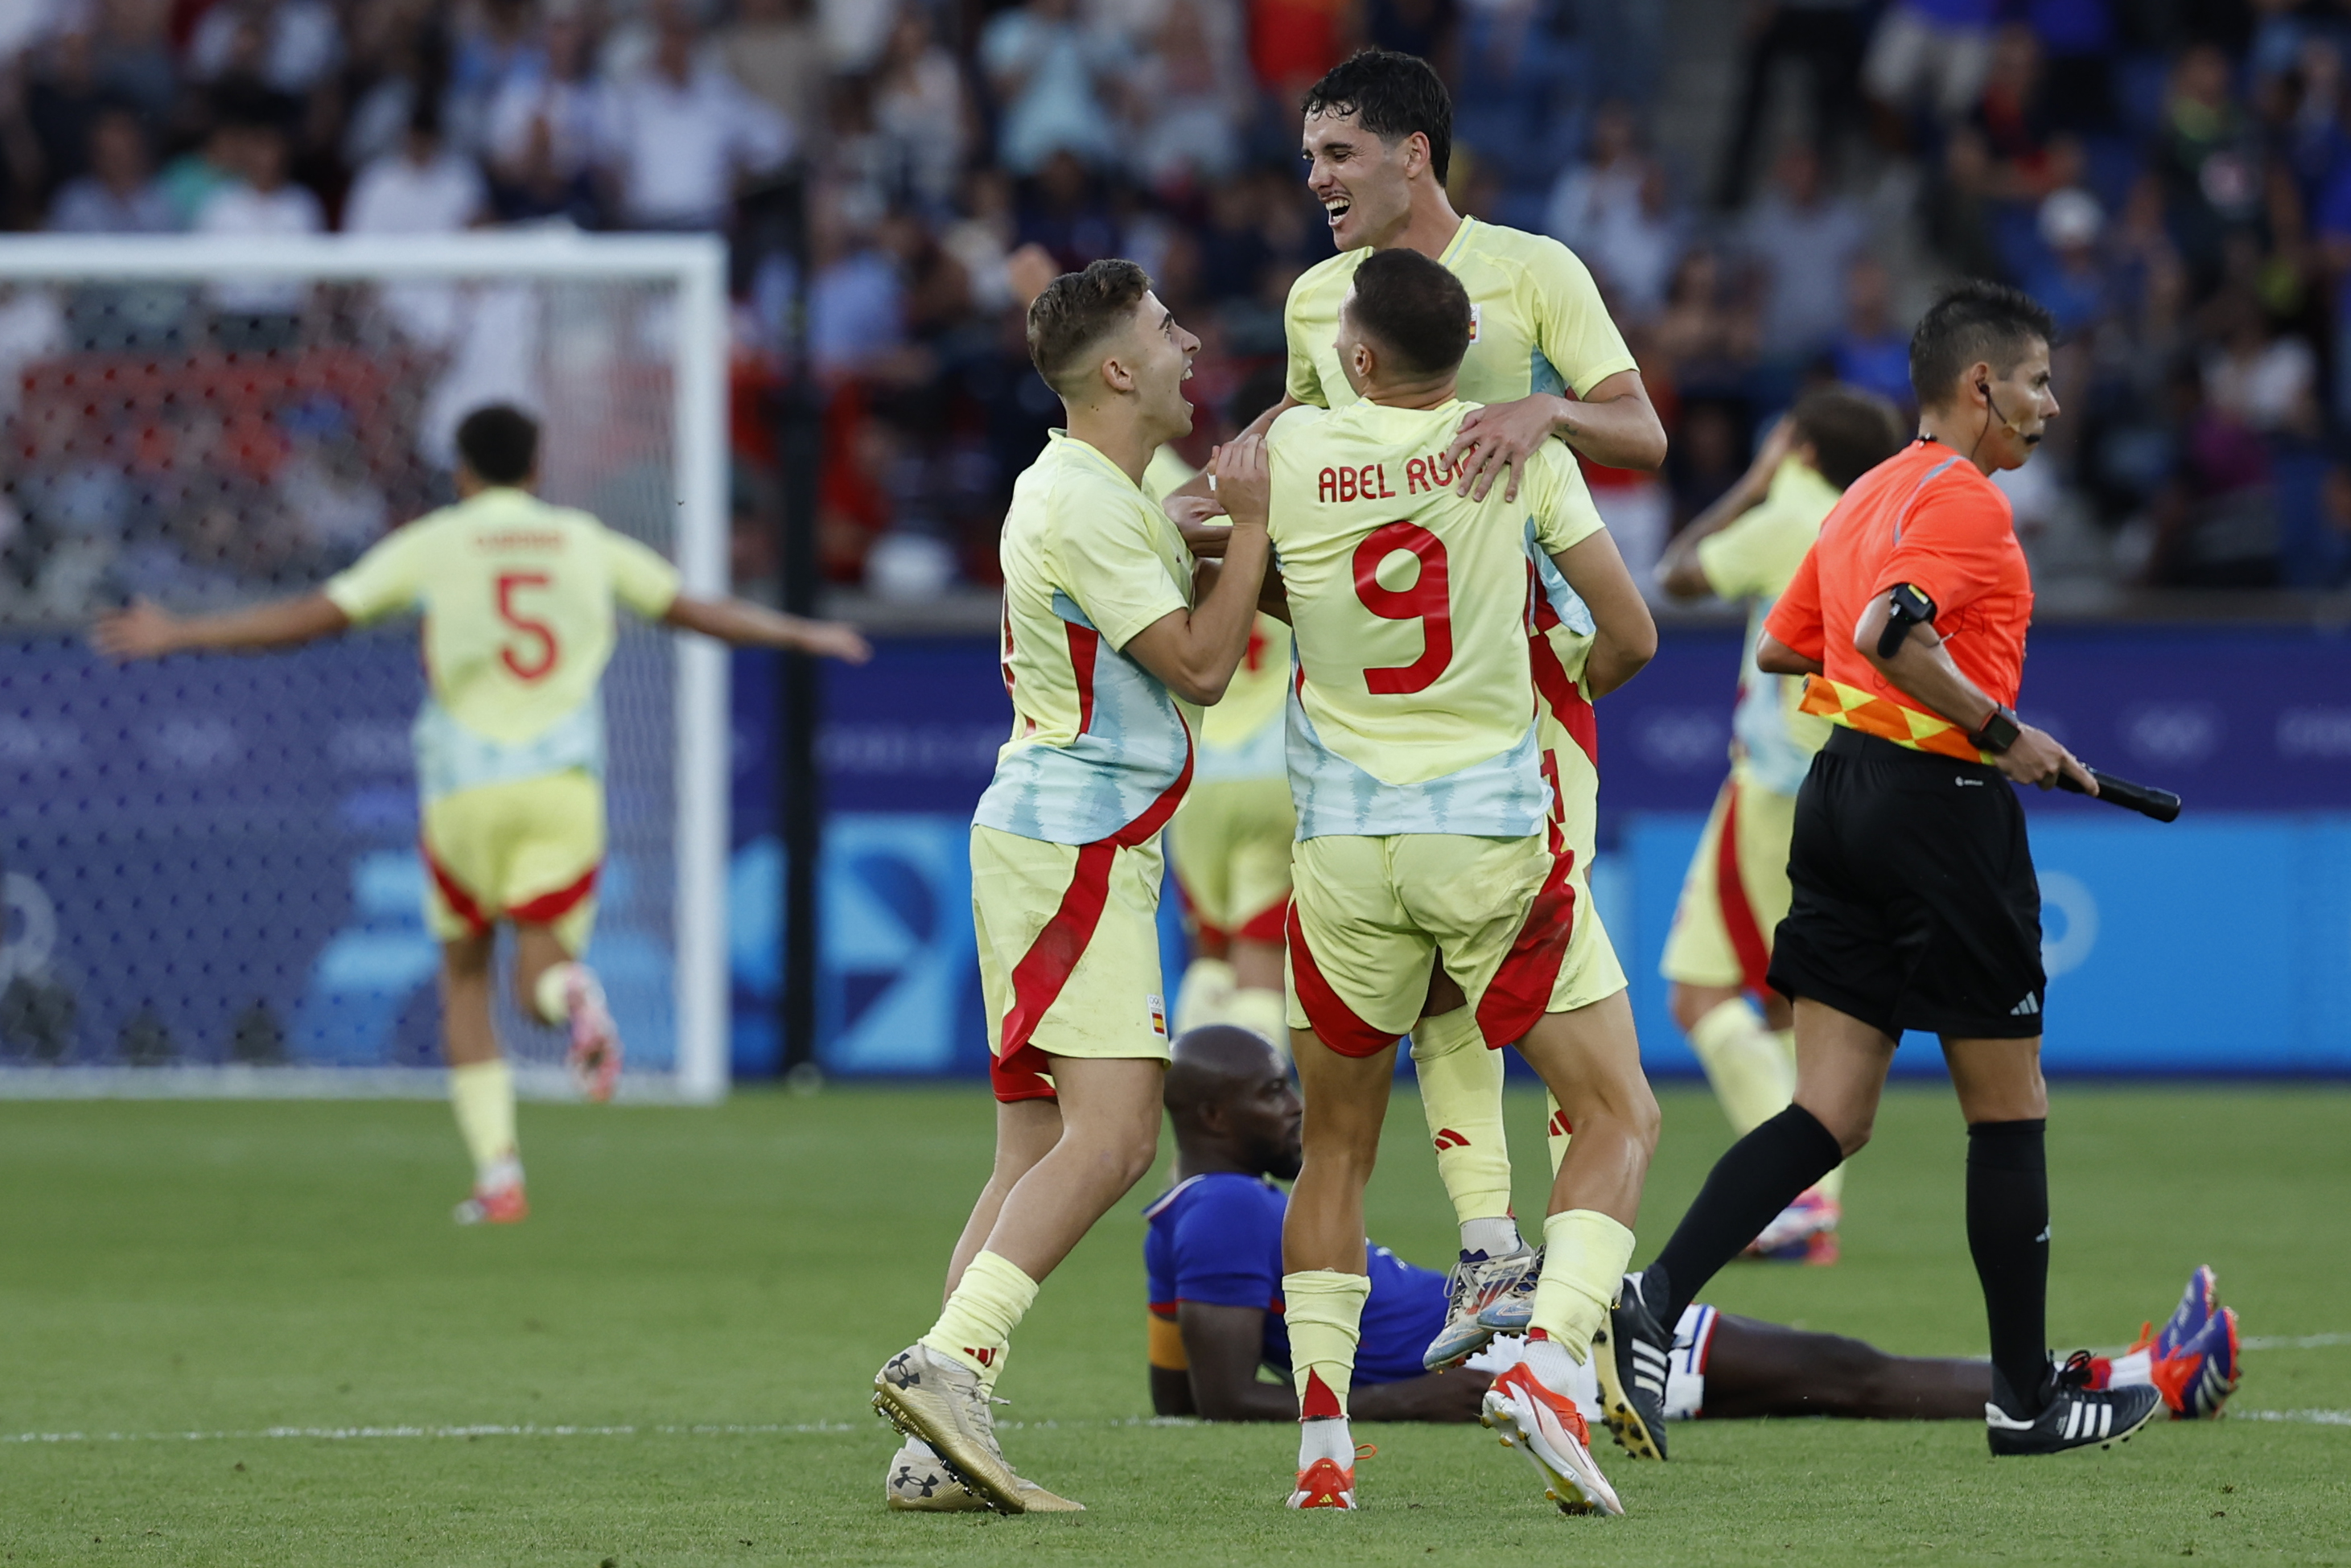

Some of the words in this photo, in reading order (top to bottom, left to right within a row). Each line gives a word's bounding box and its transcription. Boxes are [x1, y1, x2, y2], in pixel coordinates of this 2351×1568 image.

[1319, 463, 1396, 503] ABEL
[492, 571, 562, 684] 5
[1353, 520, 1453, 695] 9
[1484, 1264, 1525, 1282] F50
